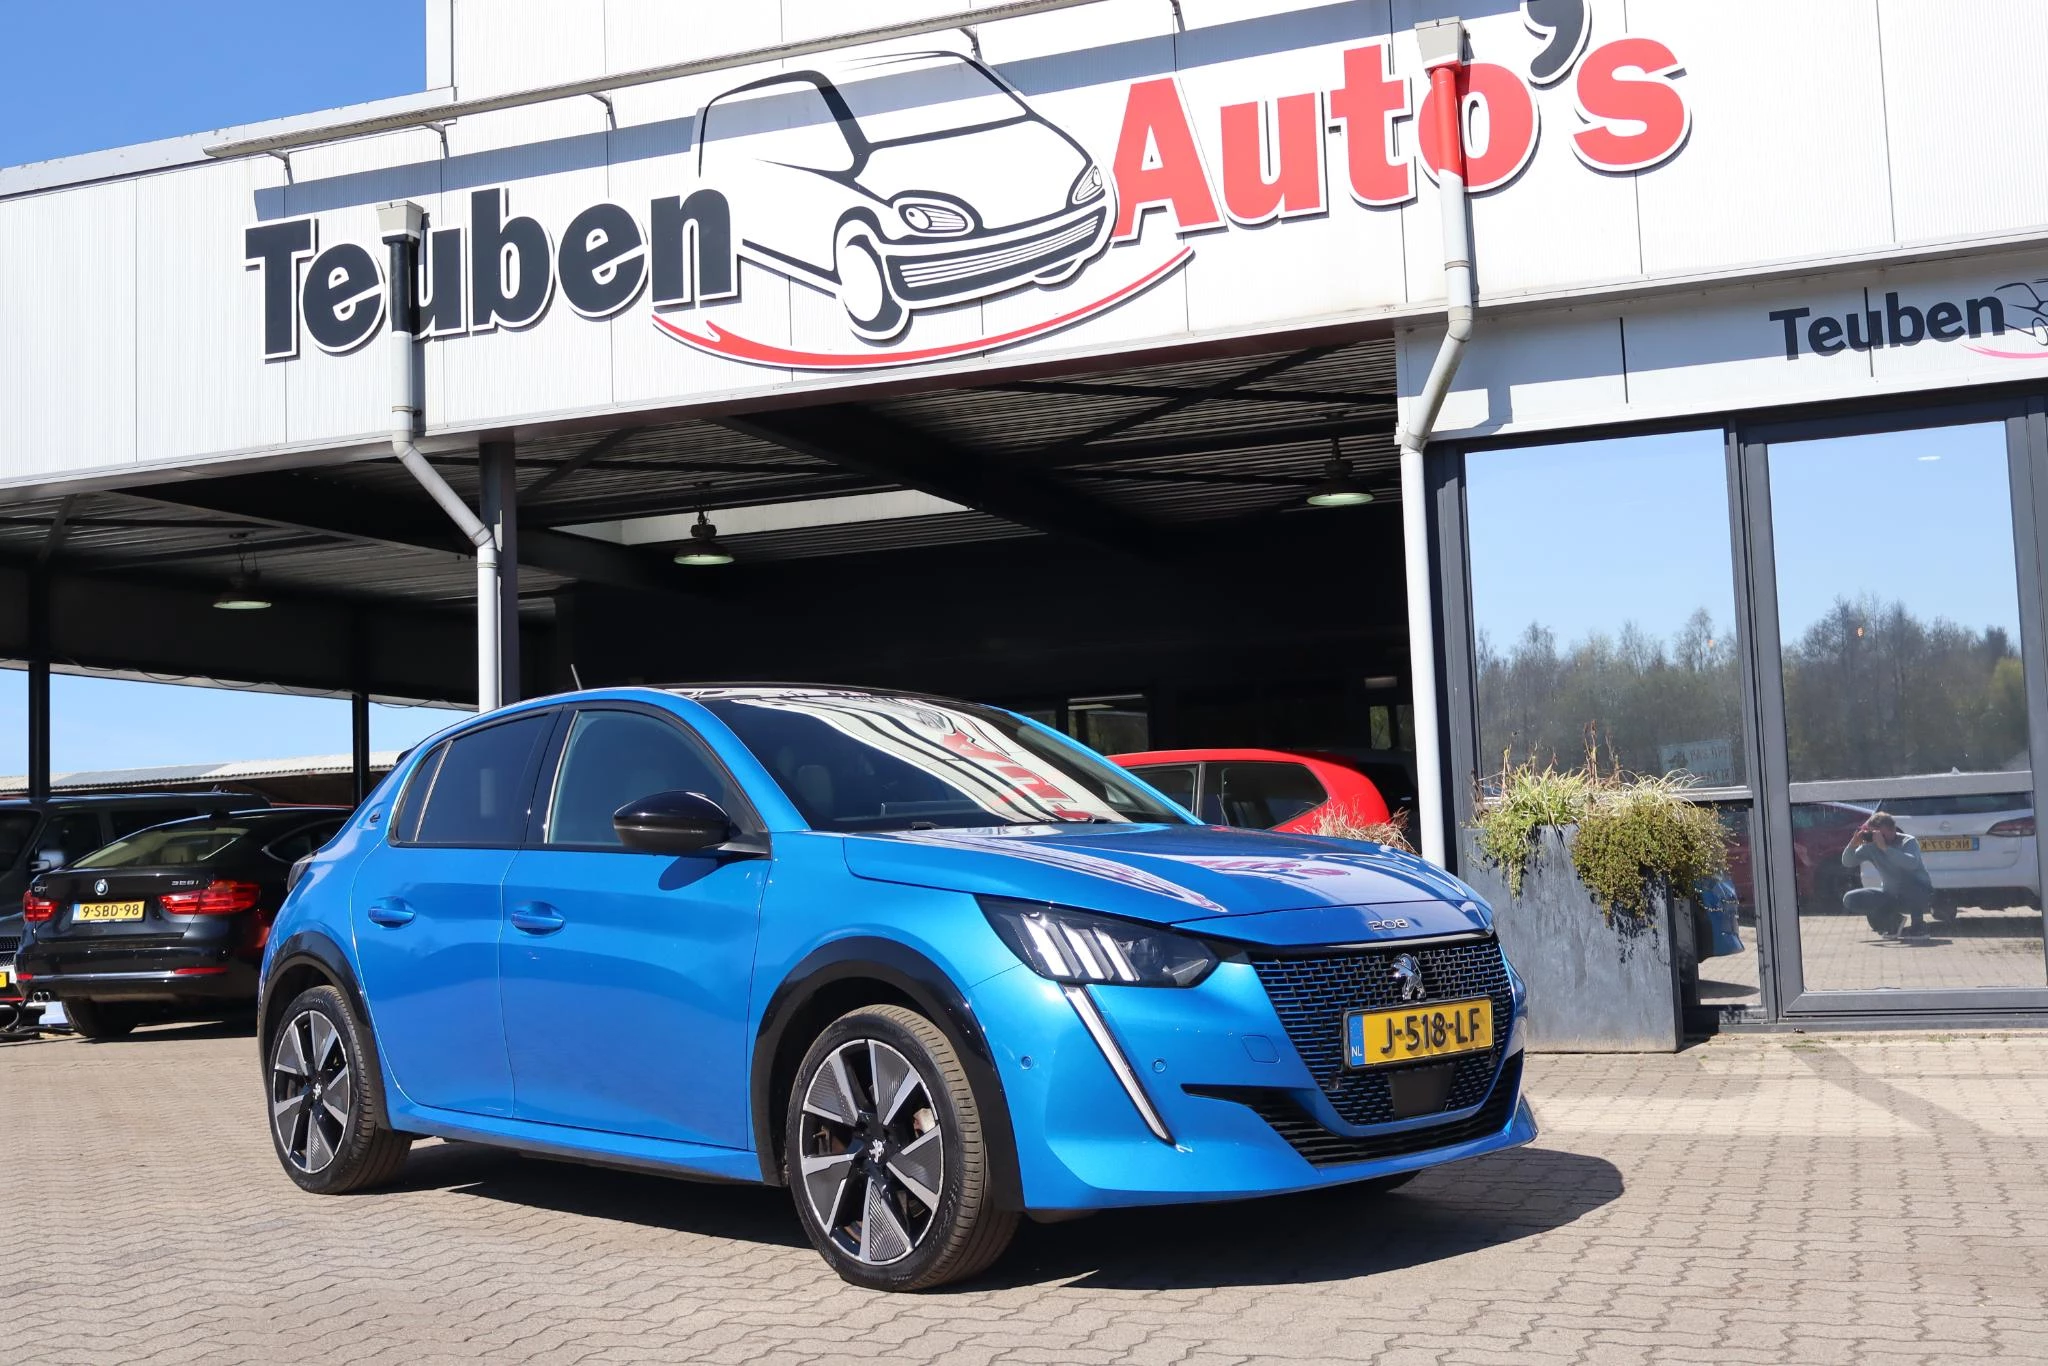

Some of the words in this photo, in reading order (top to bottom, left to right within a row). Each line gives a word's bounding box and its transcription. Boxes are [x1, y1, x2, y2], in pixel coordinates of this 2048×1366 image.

[244, 187, 731, 356] Teuben
[1112, 0, 1691, 239] Auto's
[1769, 291, 2006, 361] Teuben
[83, 904, 139, 918] 9-SBD-98
[1368, 918, 1409, 931] 208
[1381, 1008, 1480, 1054] J-518-LF
[1351, 1045, 1363, 1057] NL
